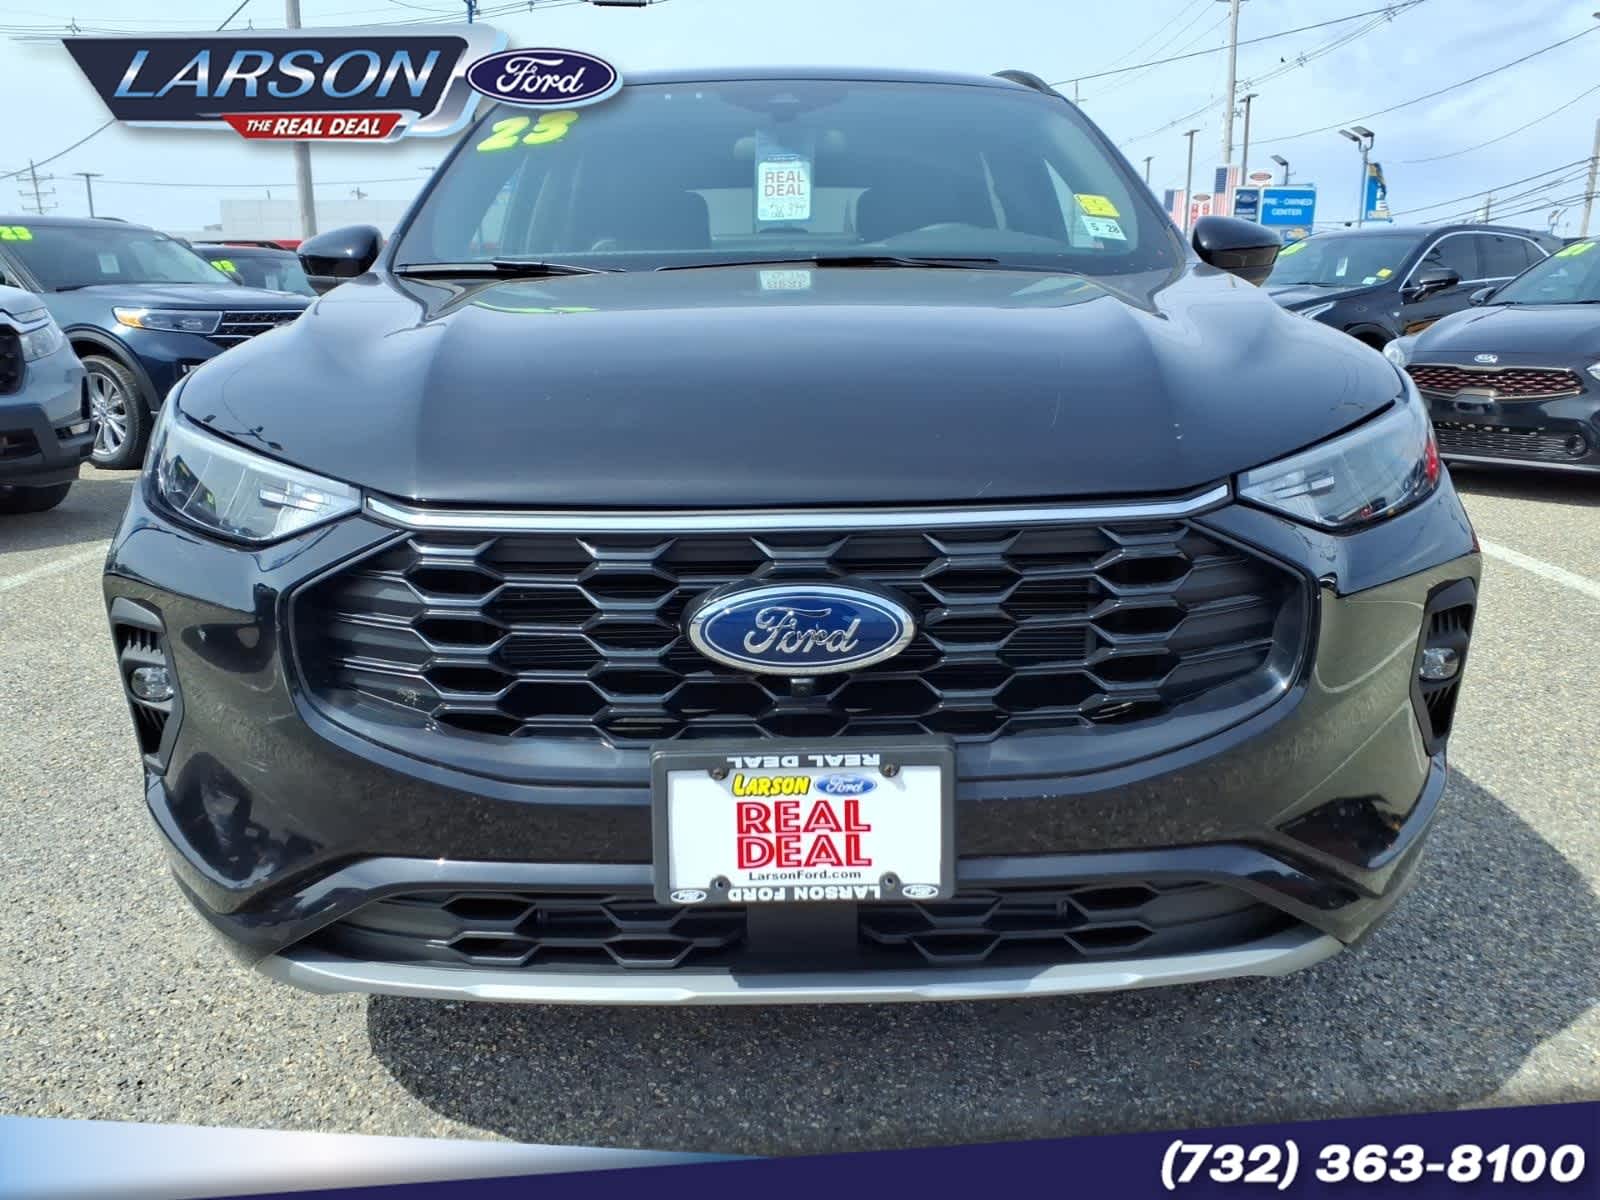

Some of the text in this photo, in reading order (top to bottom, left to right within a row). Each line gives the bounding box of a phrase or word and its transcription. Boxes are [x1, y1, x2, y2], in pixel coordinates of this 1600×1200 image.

[476, 111, 579, 151] 23
[764, 171, 805, 183] REAL
[764, 184, 805, 197] DEAL
[743, 606, 862, 654] Ford
[727, 754, 880, 769] REAL DEAL
[732, 773, 865, 797] LARSON Ford
[737, 800, 871, 834] REAL
[737, 834, 872, 869] DEAL
[749, 870, 862, 881] LarsonFord.com
[728, 885, 880, 902] LARSON FORD
